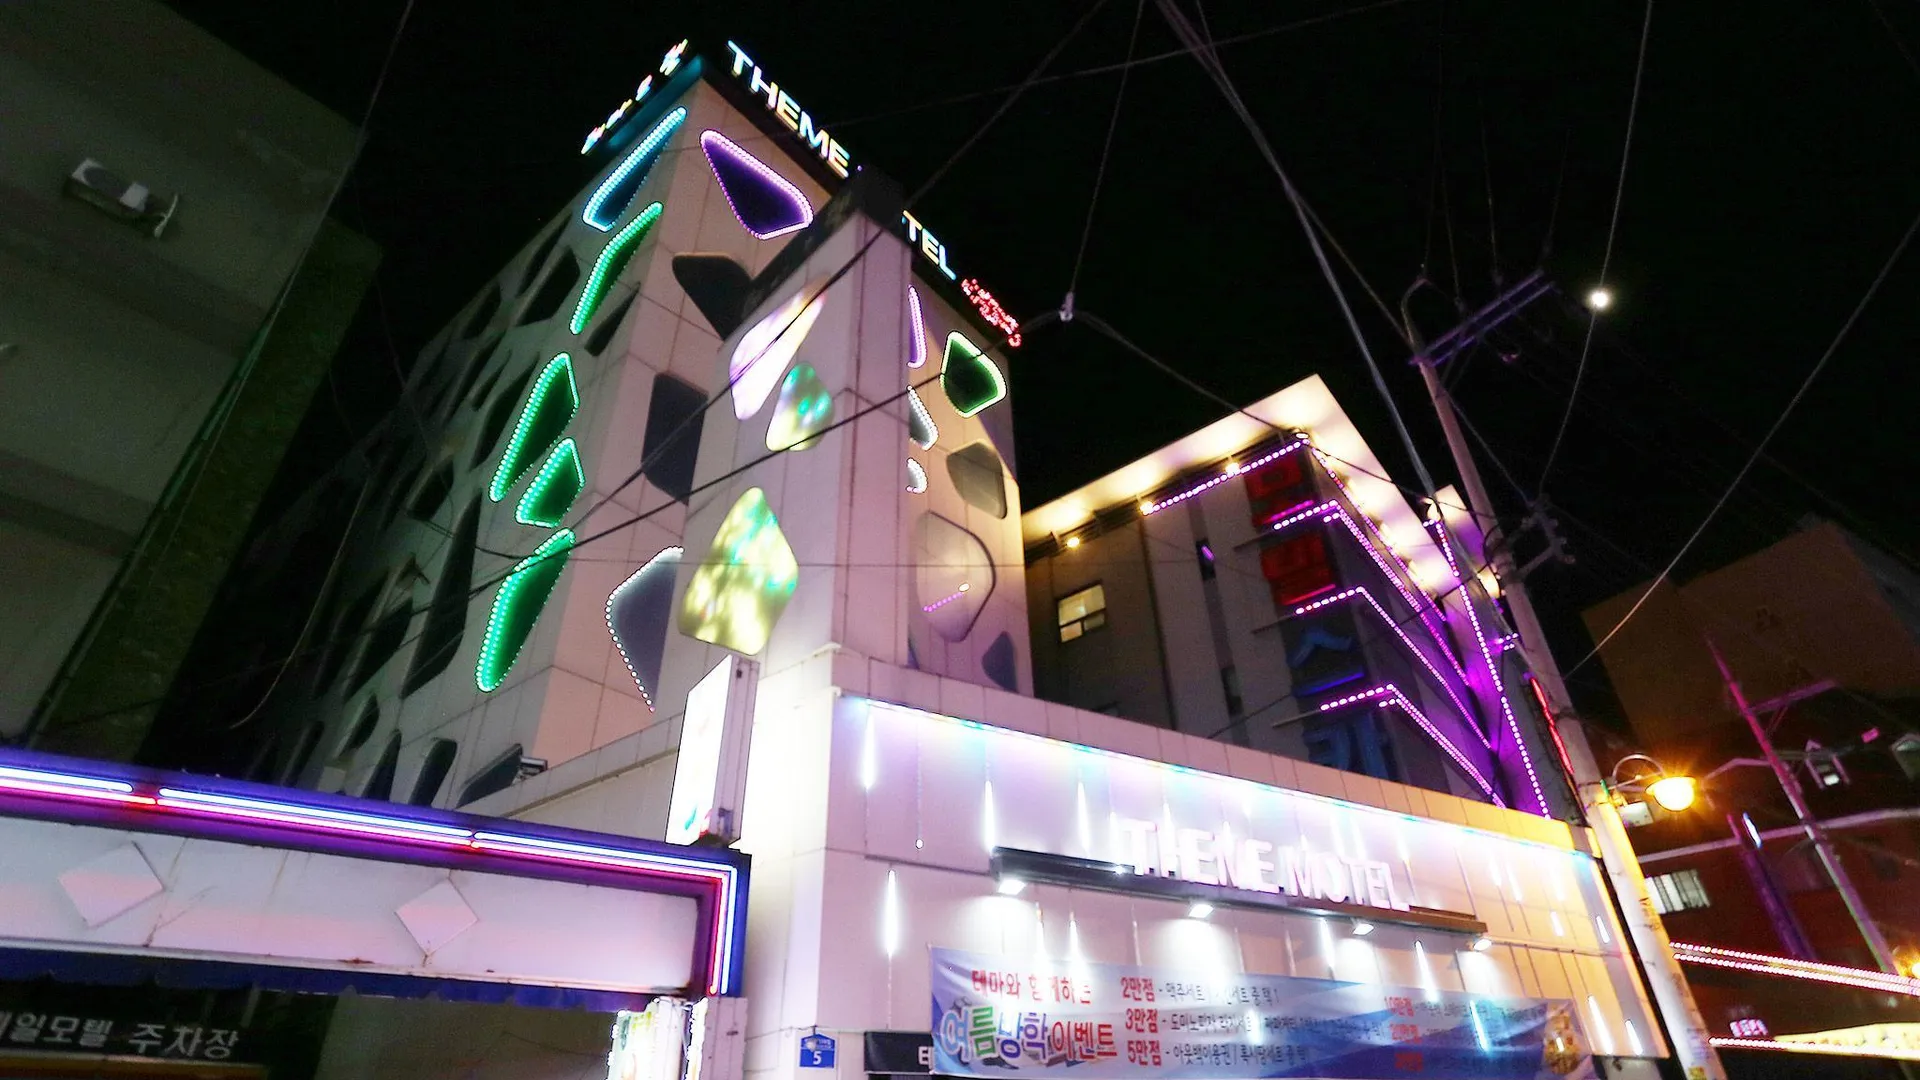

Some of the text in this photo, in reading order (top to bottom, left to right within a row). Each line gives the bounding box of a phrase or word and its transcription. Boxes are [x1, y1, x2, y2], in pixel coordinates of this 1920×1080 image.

[726, 39, 851, 178] THEME
[1280, 844, 1410, 912] MOTEL
[971, 969, 1021, 998] 테마와
[1121, 976, 1155, 1002] 2만점
[1125, 1008, 1159, 1033] 3만점
[128, 1022, 240, 1060] 주차장
[1127, 1040, 1162, 1067] 5만점
[812, 1050, 822, 1065] 5
